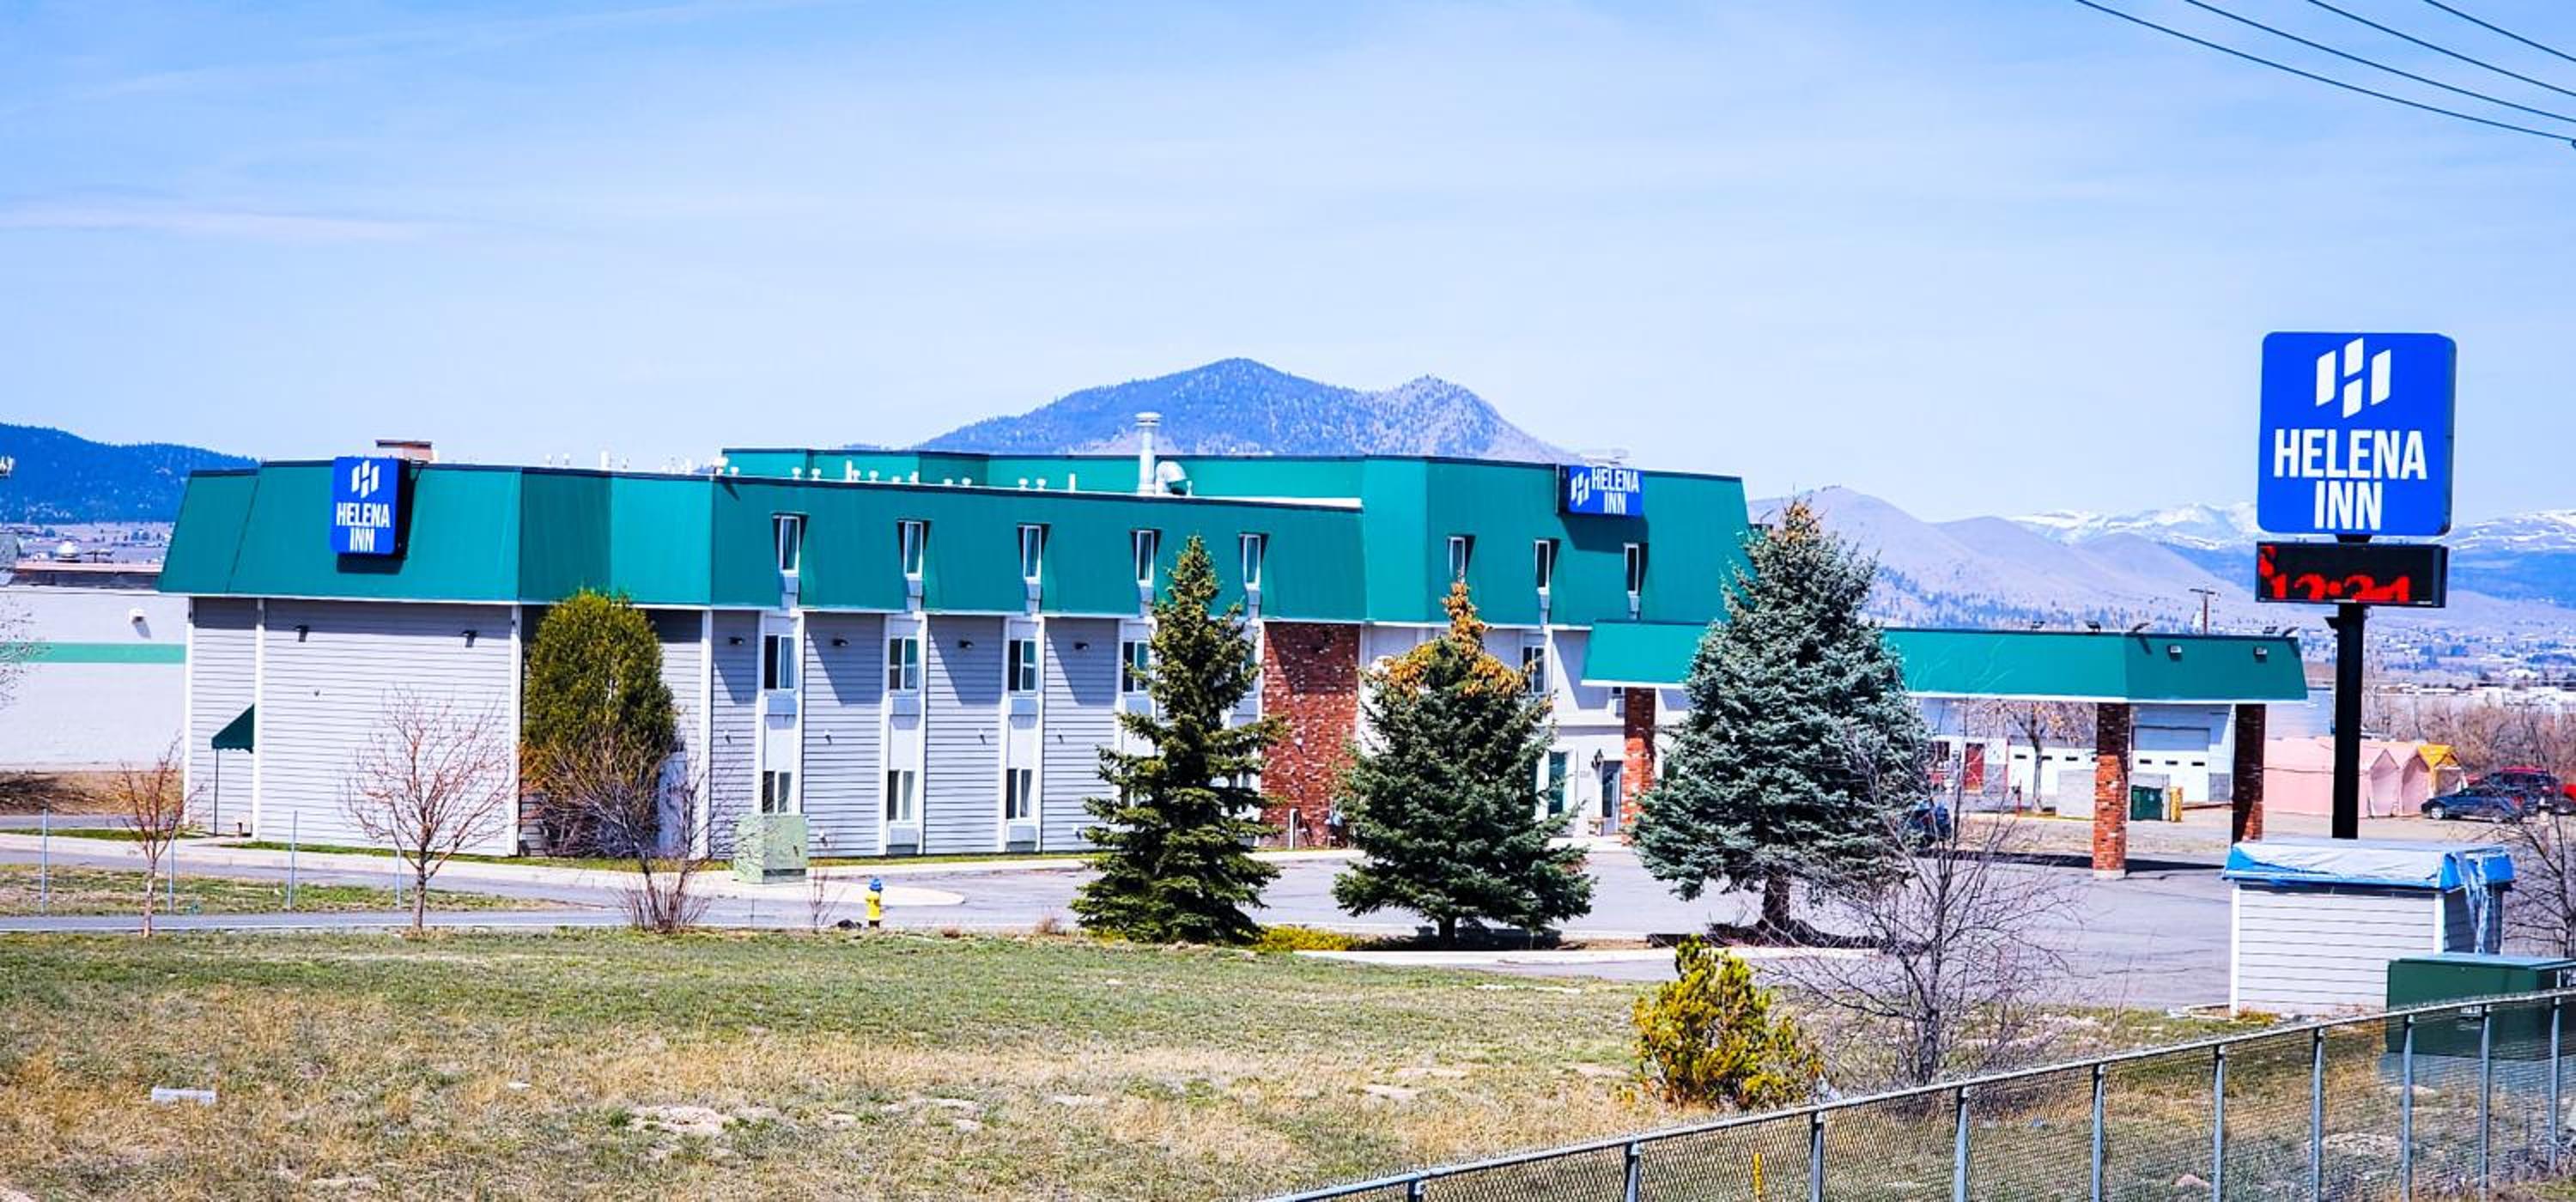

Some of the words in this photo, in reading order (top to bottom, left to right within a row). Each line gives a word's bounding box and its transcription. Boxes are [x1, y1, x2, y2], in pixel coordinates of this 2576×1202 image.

[2274, 428, 2427, 479] HELENA
[1591, 468, 1640, 493] HELENA
[336, 502, 391, 528] HELENA
[1603, 492, 1627, 514] INN
[2313, 480, 2383, 531] INN
[349, 527, 375, 552] INN
